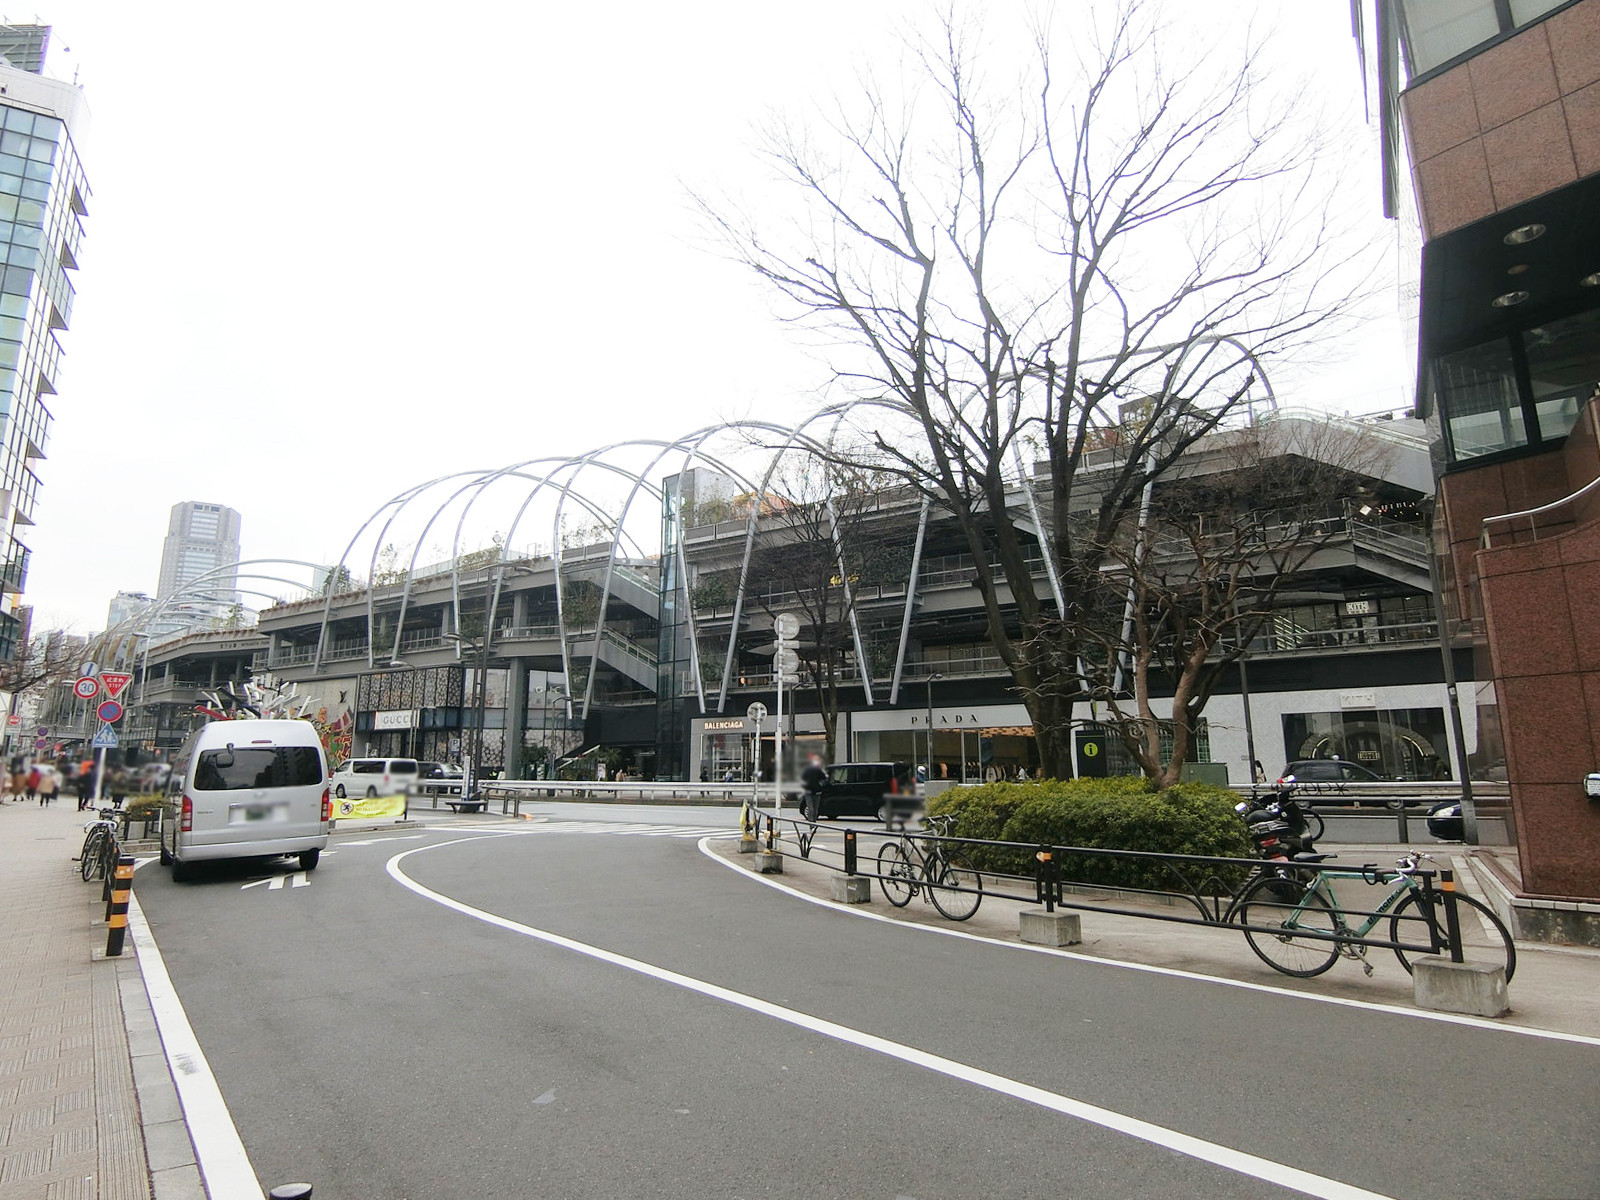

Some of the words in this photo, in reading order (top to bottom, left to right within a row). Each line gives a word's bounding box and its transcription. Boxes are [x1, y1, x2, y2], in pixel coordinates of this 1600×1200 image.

[80, 682, 94, 693] 30
[383, 714, 412, 724] GUCC
[704, 721, 744, 730] BALENCIAGA
